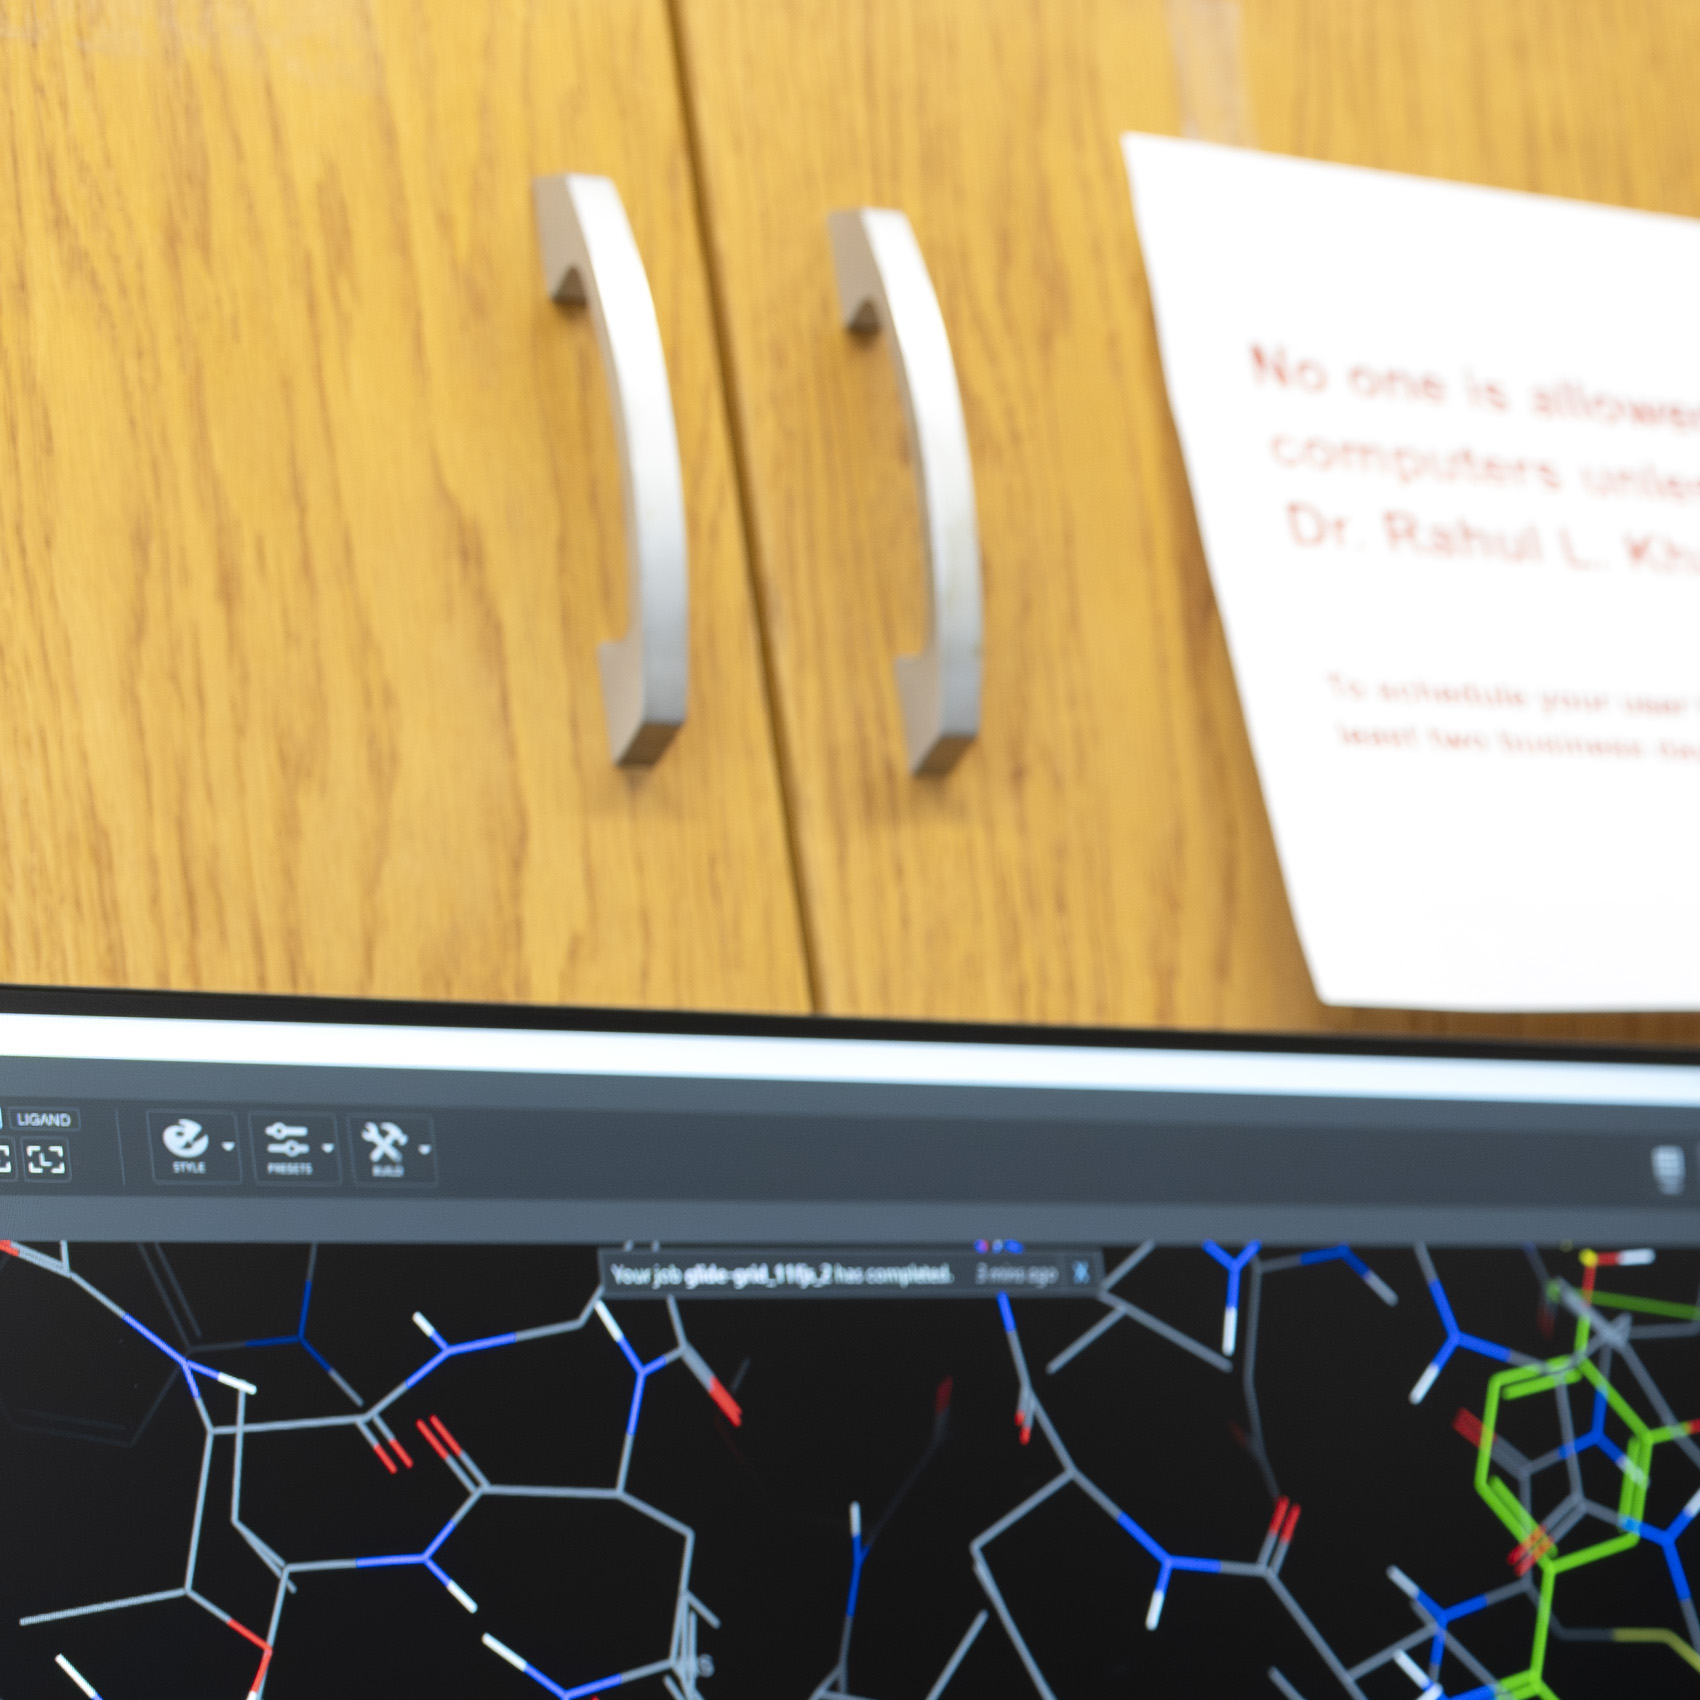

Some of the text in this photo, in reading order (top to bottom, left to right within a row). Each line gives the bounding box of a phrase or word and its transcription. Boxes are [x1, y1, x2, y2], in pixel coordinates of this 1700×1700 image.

[1249, 340, 1328, 394] No
[1348, 363, 1448, 407] one
[1461, 365, 1511, 413] is
[1270, 432, 1561, 492] computers
[1382, 508, 1545, 563] Rahul
[17, 1112, 71, 1127] LIGAND
[173, 1161, 206, 1175] STYLE
[267, 1162, 313, 1175] PRESETS
[610, 1263, 650, 1285] Your
[652, 1263, 682, 1289] job
